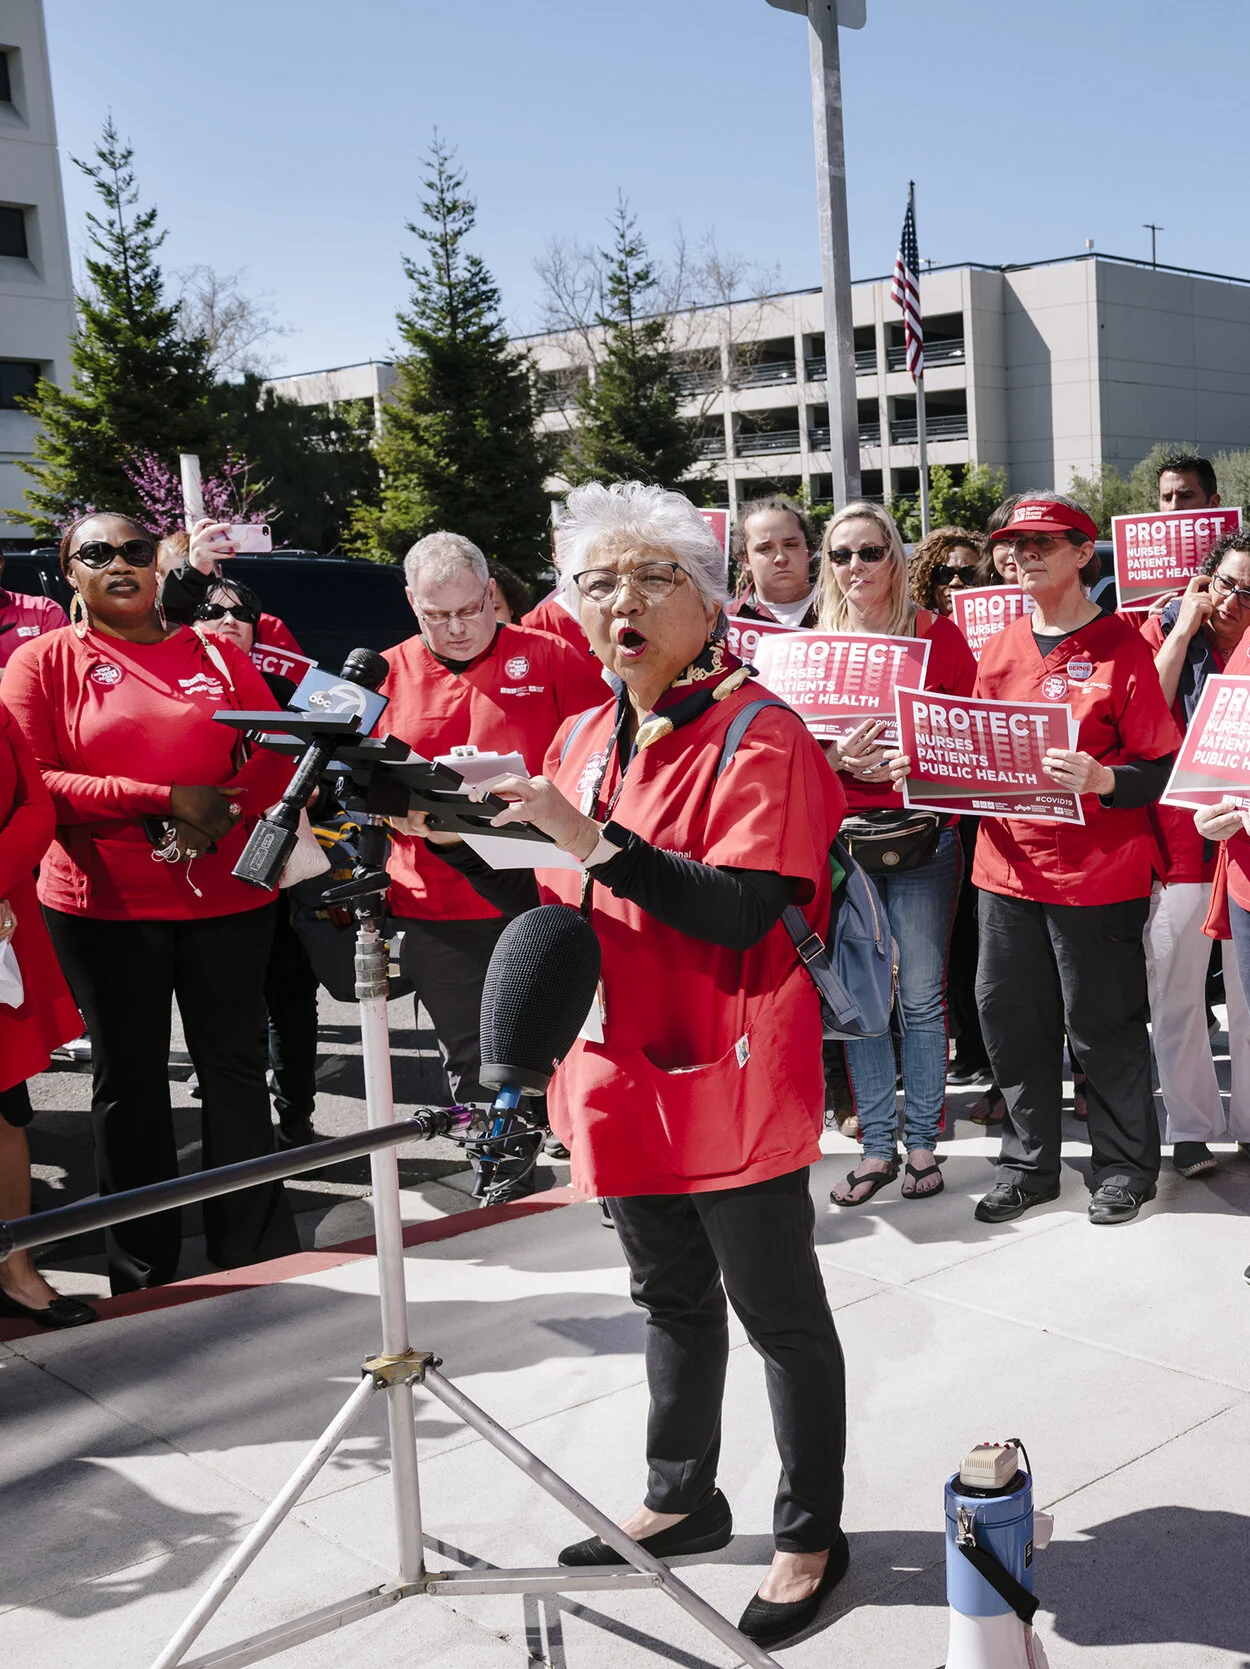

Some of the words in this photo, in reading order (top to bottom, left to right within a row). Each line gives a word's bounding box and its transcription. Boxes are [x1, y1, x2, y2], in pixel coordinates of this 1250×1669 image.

[1125, 517, 1225, 542] PROTECT
[1126, 545, 1167, 558] NURSES
[1127, 556, 1177, 569] PATIENTS
[1128, 569, 1164, 580] PUBLIC
[1166, 567, 1204, 578] HEALT
[772, 641, 909, 666] PROTECT
[771, 667, 825, 680] NURSES
[768, 680, 836, 693] PATIENTS
[309, 691, 332, 708] abc
[823, 693, 880, 708] HEALTH
[912, 700, 1049, 737] PROTECT
[916, 732, 974, 751] NURSES
[917, 748, 989, 767] PATIENTS
[1191, 750, 1241, 769] PUBLIC
[919, 761, 972, 779] PUBLIC
[976, 768, 1038, 785] HEALTH
[1035, 795, 1074, 806] #COVID19
